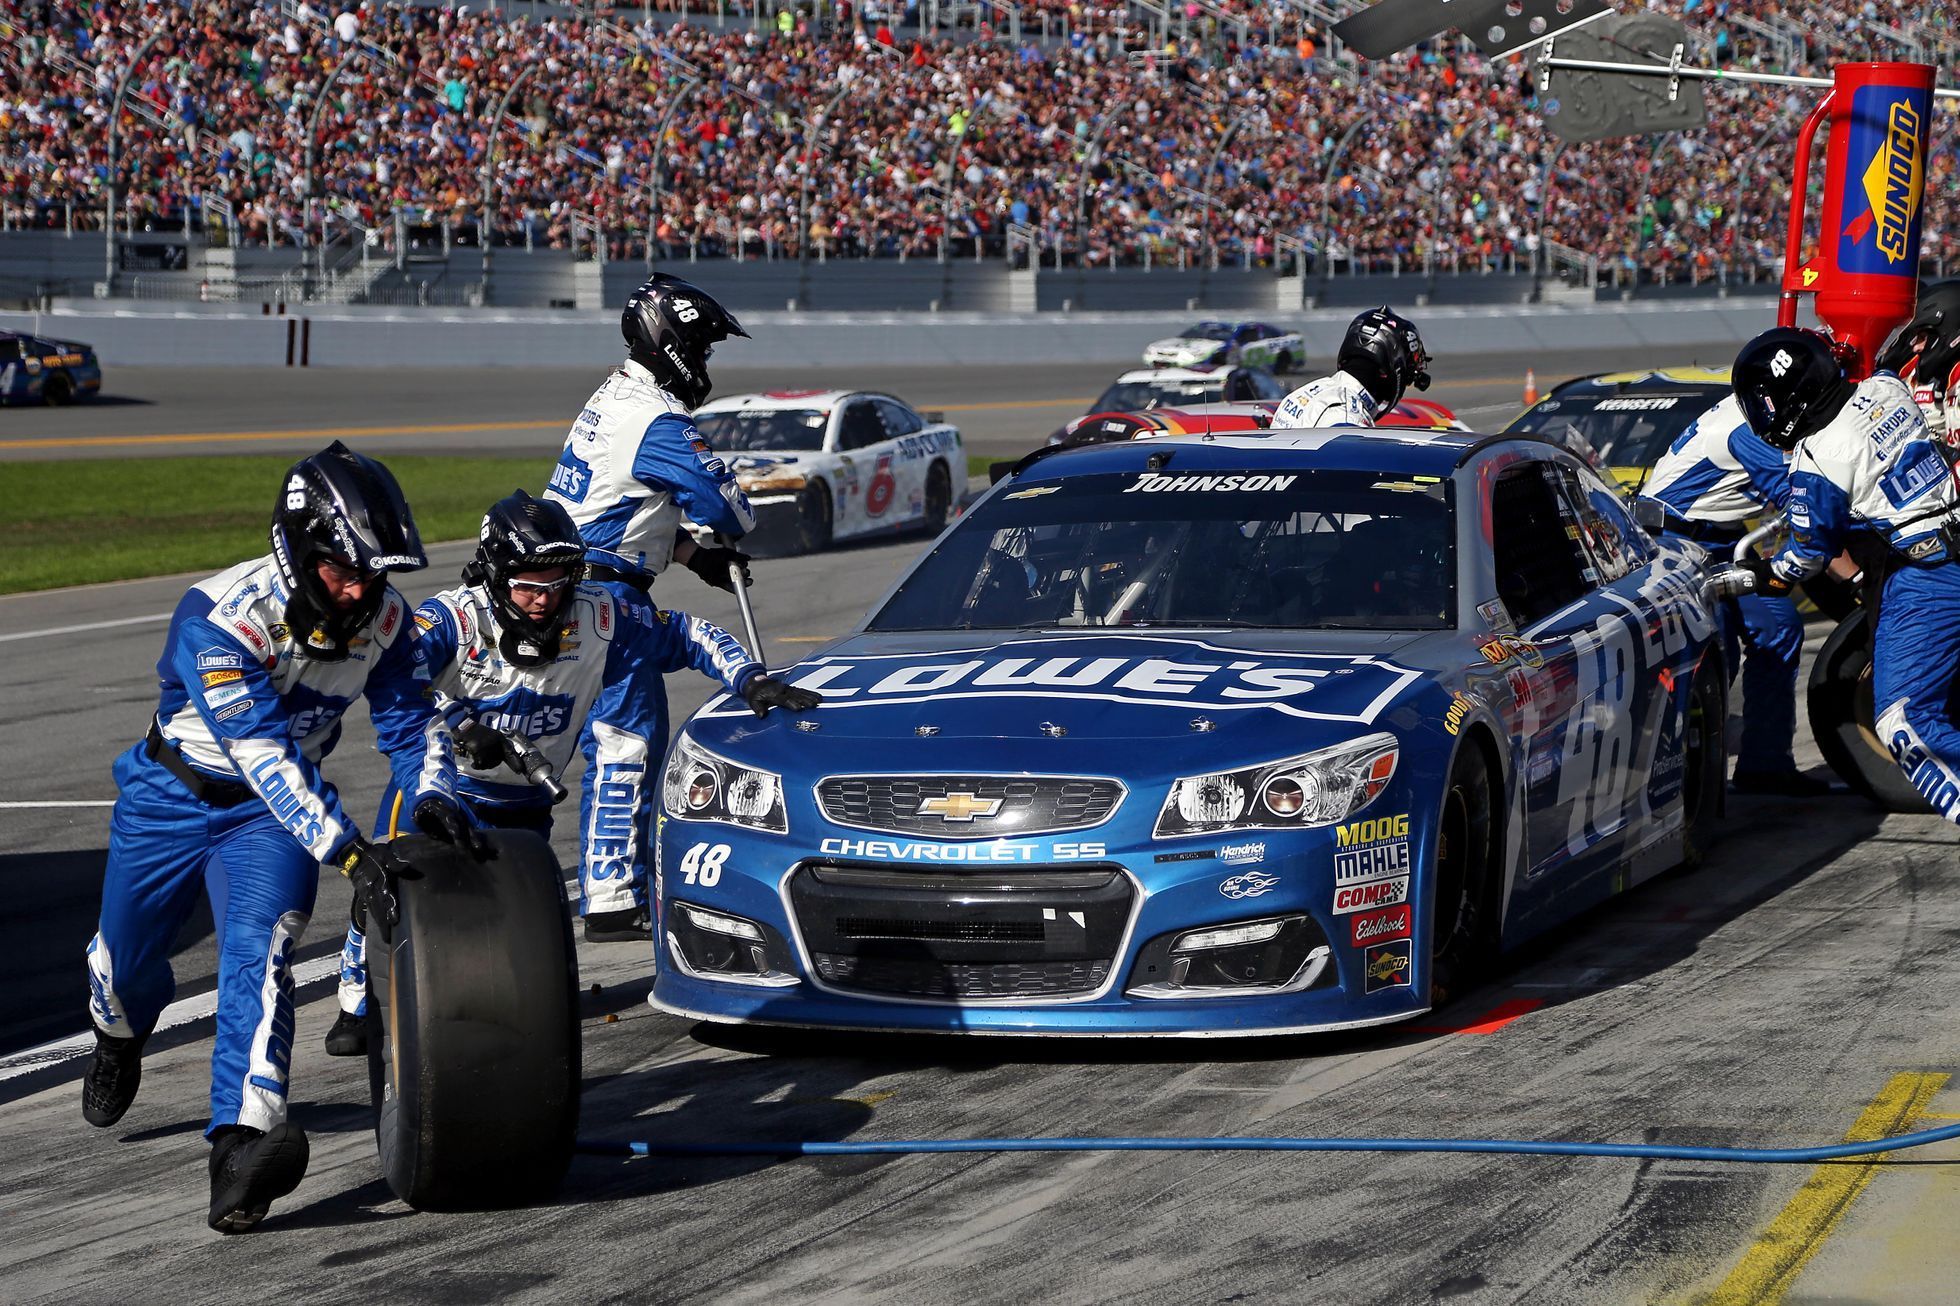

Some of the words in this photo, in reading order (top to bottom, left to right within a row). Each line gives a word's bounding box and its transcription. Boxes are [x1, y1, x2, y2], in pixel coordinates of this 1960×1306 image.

[1881, 107, 1918, 256] SUNOCO
[672, 299, 699, 323] 48
[1407, 331, 1419, 352] 48
[664, 344, 692, 382] LOWE'S
[1770, 349, 1793, 378] 48
[1594, 398, 1679, 411] KENSETH
[1870, 406, 1911, 445] HARDER
[286, 474, 306, 511] 48
[866, 452, 896, 518] 6
[1122, 473, 1298, 493] JOHNSON
[383, 555, 421, 567] KOBALT
[236, 622, 264, 650] SIMPSON
[201, 655, 239, 667] LOWE'S
[210, 672, 240, 682] BOSCH
[794, 657, 1343, 699] LOWE'S
[249, 755, 325, 847] LOWE'S
[591, 763, 645, 882] LOWE'S
[1336, 813, 1409, 848] MOOG
[819, 837, 1040, 861] CHEVROLET
[1053, 842, 1106, 859] SS
[1220, 841, 1266, 860] Hendrick
[1336, 843, 1408, 880] MAHLE
[679, 842, 732, 887] 48
[1336, 882, 1392, 909] COMP
[1375, 894, 1399, 906] CAMS
[1355, 912, 1406, 941] Edelbrock
[1369, 957, 1406, 977] SUNOCO
